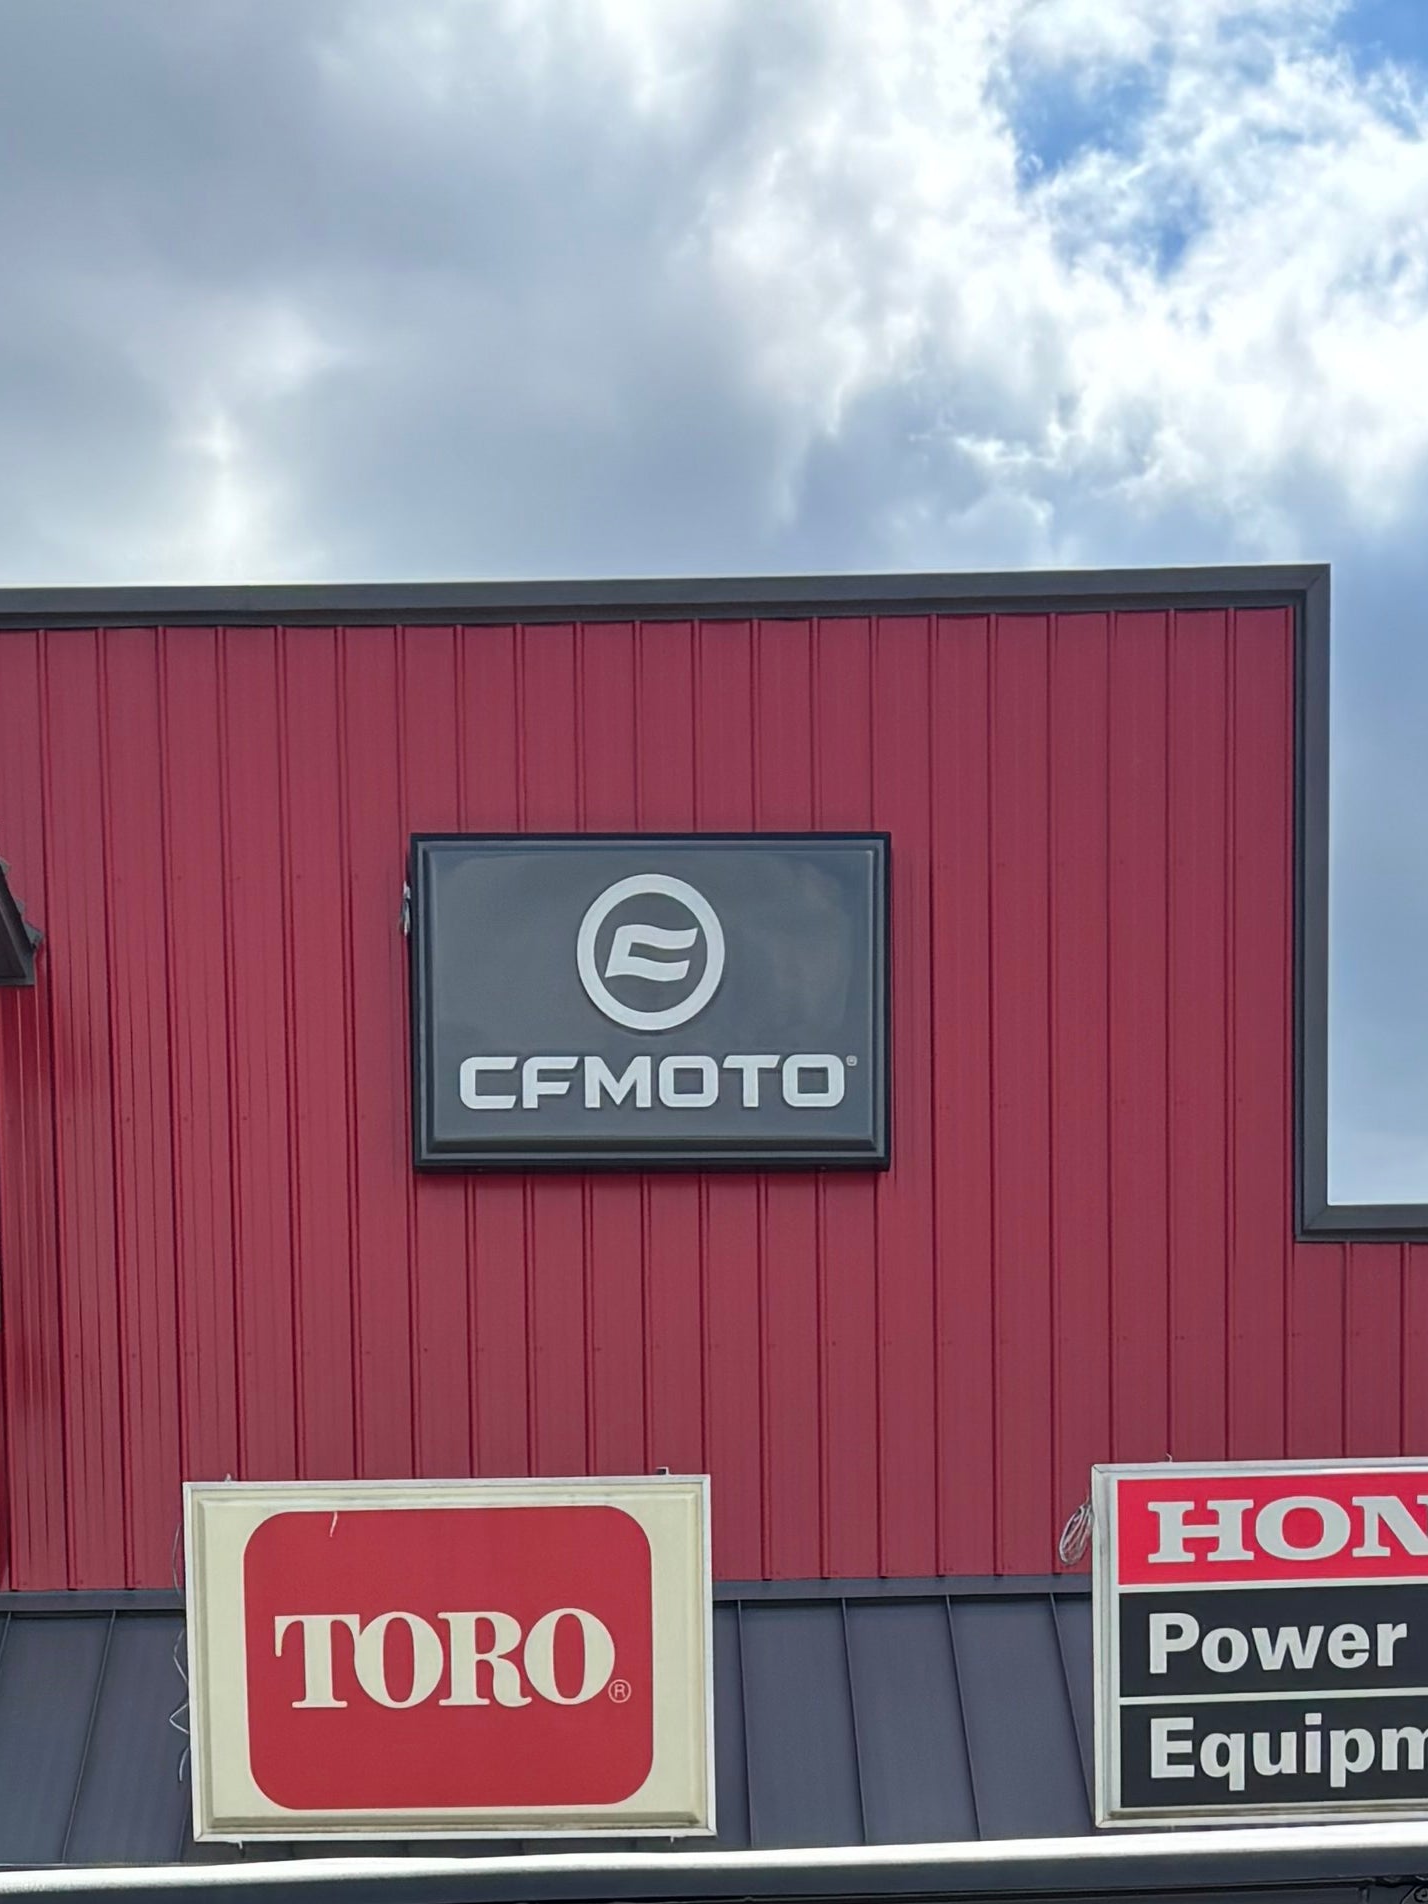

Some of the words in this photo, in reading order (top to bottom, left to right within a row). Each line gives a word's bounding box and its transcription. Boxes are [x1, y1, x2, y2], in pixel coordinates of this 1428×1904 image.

[459, 1053, 845, 1110] CFMOTO
[274, 1607, 616, 1709] TORO
[1149, 1612, 1409, 1674] Power
